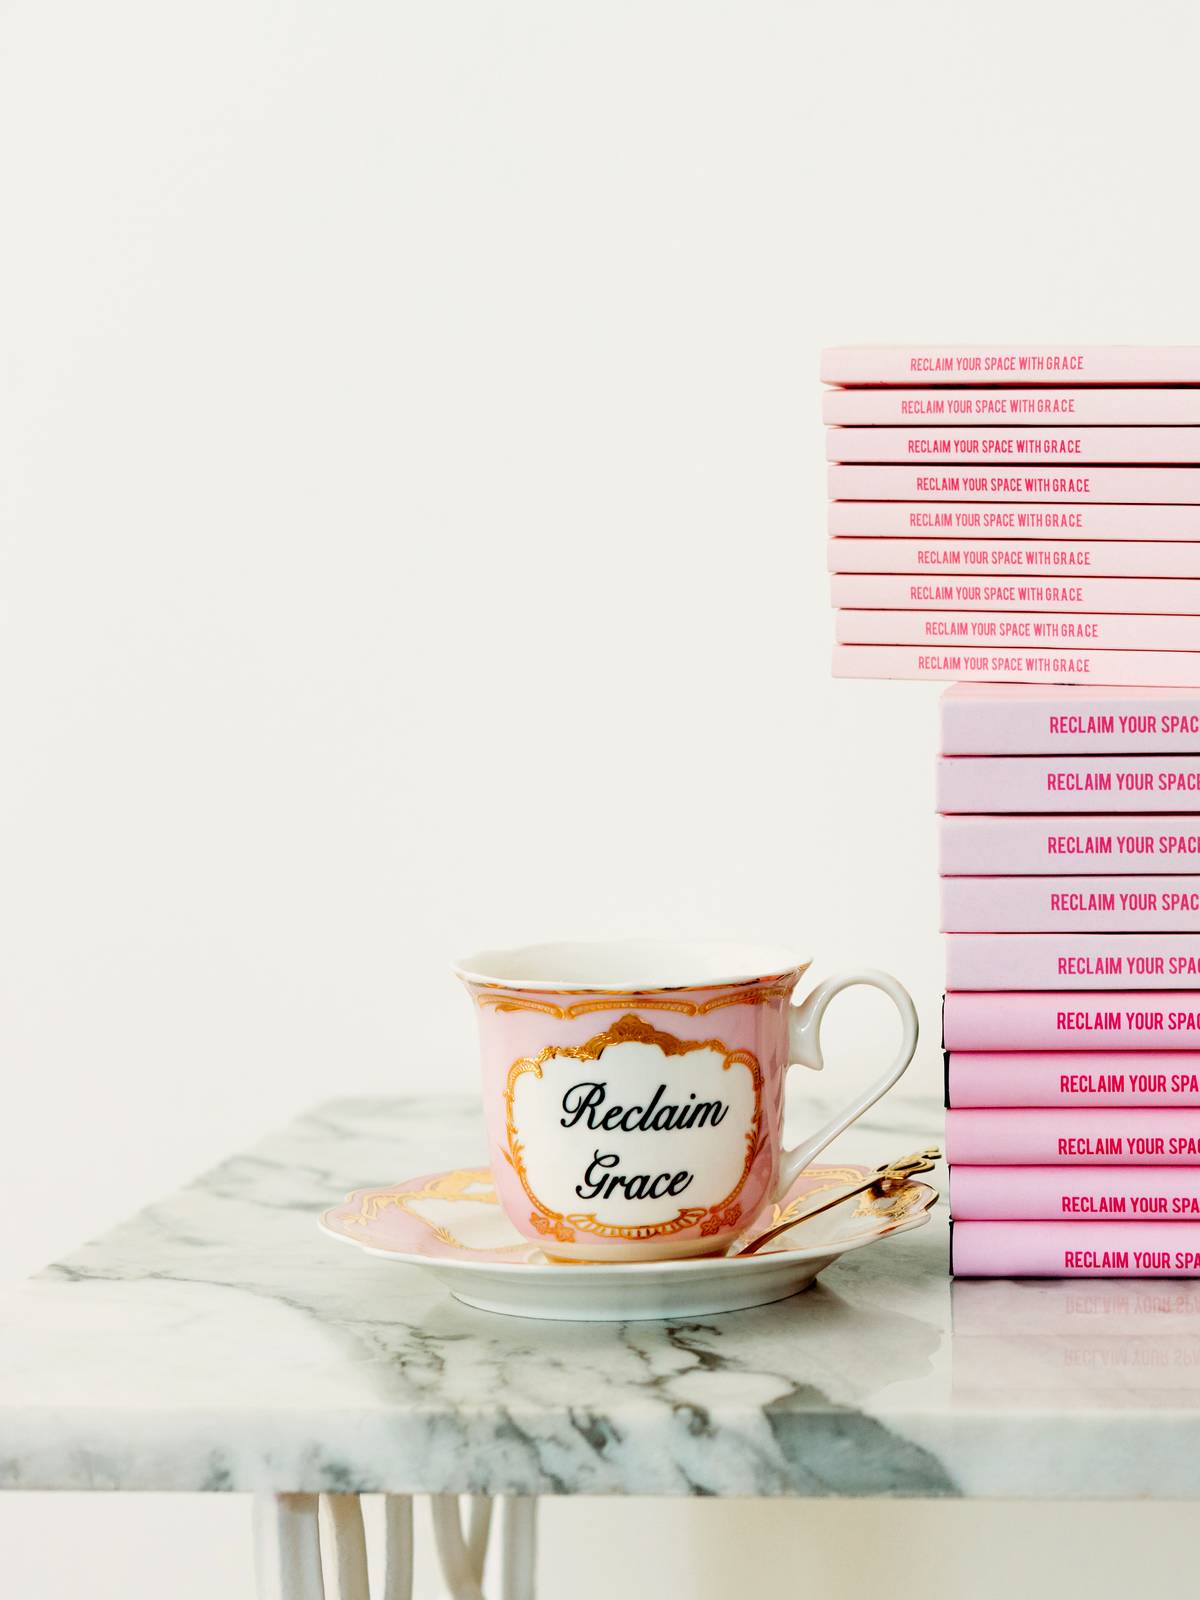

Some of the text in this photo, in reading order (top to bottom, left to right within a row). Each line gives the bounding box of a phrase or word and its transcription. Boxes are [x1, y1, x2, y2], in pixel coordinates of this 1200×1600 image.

[910, 356, 954, 372] RECLAIM
[955, 356, 982, 371] YOUR
[984, 356, 1017, 371] SPACE
[1018, 355, 1045, 371] WITH
[901, 399, 945, 415] RECLAIM
[947, 399, 973, 414] YOUR
[975, 399, 1007, 414] SPACE
[1009, 399, 1035, 414] WITH
[907, 439, 952, 454] RECLAIM
[953, 439, 980, 454] YOUR
[981, 439, 1014, 454] SPACE
[1015, 439, 1042, 454] WITH
[916, 476, 960, 492] RECLAIM
[961, 477, 989, 492] YOUR
[990, 477, 1023, 493] SPACE
[1024, 477, 1051, 493] WITH
[909, 512, 953, 528] RECLAIM
[954, 512, 981, 528] YOUR
[983, 513, 1016, 528] SPACE
[1017, 513, 1043, 528] WITH
[917, 550, 961, 565] RECLAIM
[962, 550, 989, 565] YOUR
[991, 550, 1024, 565] SPACE
[1025, 550, 1051, 566] WITH
[910, 585, 954, 601] RECLAIM
[955, 586, 982, 601] YOUR
[983, 586, 1016, 601] SPACE
[1017, 586, 1044, 601] WITH
[925, 621, 969, 636] RECLAIM
[970, 622, 997, 637] YOUR
[999, 622, 1031, 637] SPACE
[1032, 623, 1059, 638] WITH
[917, 655, 962, 671] RECLAIM
[963, 656, 989, 671] YOUR
[991, 657, 1024, 672] SPACE
[1025, 657, 1051, 672] WITH
[1049, 715, 1115, 735] RECLAIM
[1117, 714, 1158, 734] YOUR
[1046, 772, 1112, 792] RECLAIM
[1115, 772, 1155, 792] YOUR
[1047, 835, 1113, 855] RECLAIM
[1115, 835, 1155, 855] YOUR
[1050, 892, 1116, 912] RECLAIM
[1118, 892, 1158, 912] YOUR
[1057, 956, 1123, 976] RECLAIM
[1125, 956, 1165, 975] YOUR
[1056, 1011, 1122, 1031] RECLAIM
[1125, 1011, 1164, 1031] YOUR
[1059, 1074, 1125, 1093] RECLAIM
[1128, 1074, 1167, 1093] YOUR
[560, 1081, 730, 1133] Reclaim
[1057, 1136, 1123, 1156] RECLAIM
[1126, 1137, 1165, 1155] YOUR
[575, 1148, 695, 1201] Grace
[1061, 1195, 1127, 1213] RECLAIM
[1129, 1196, 1169, 1214] YOUR
[1064, 1249, 1129, 1269] RECLAIM
[1132, 1251, 1171, 1269] YOUR
